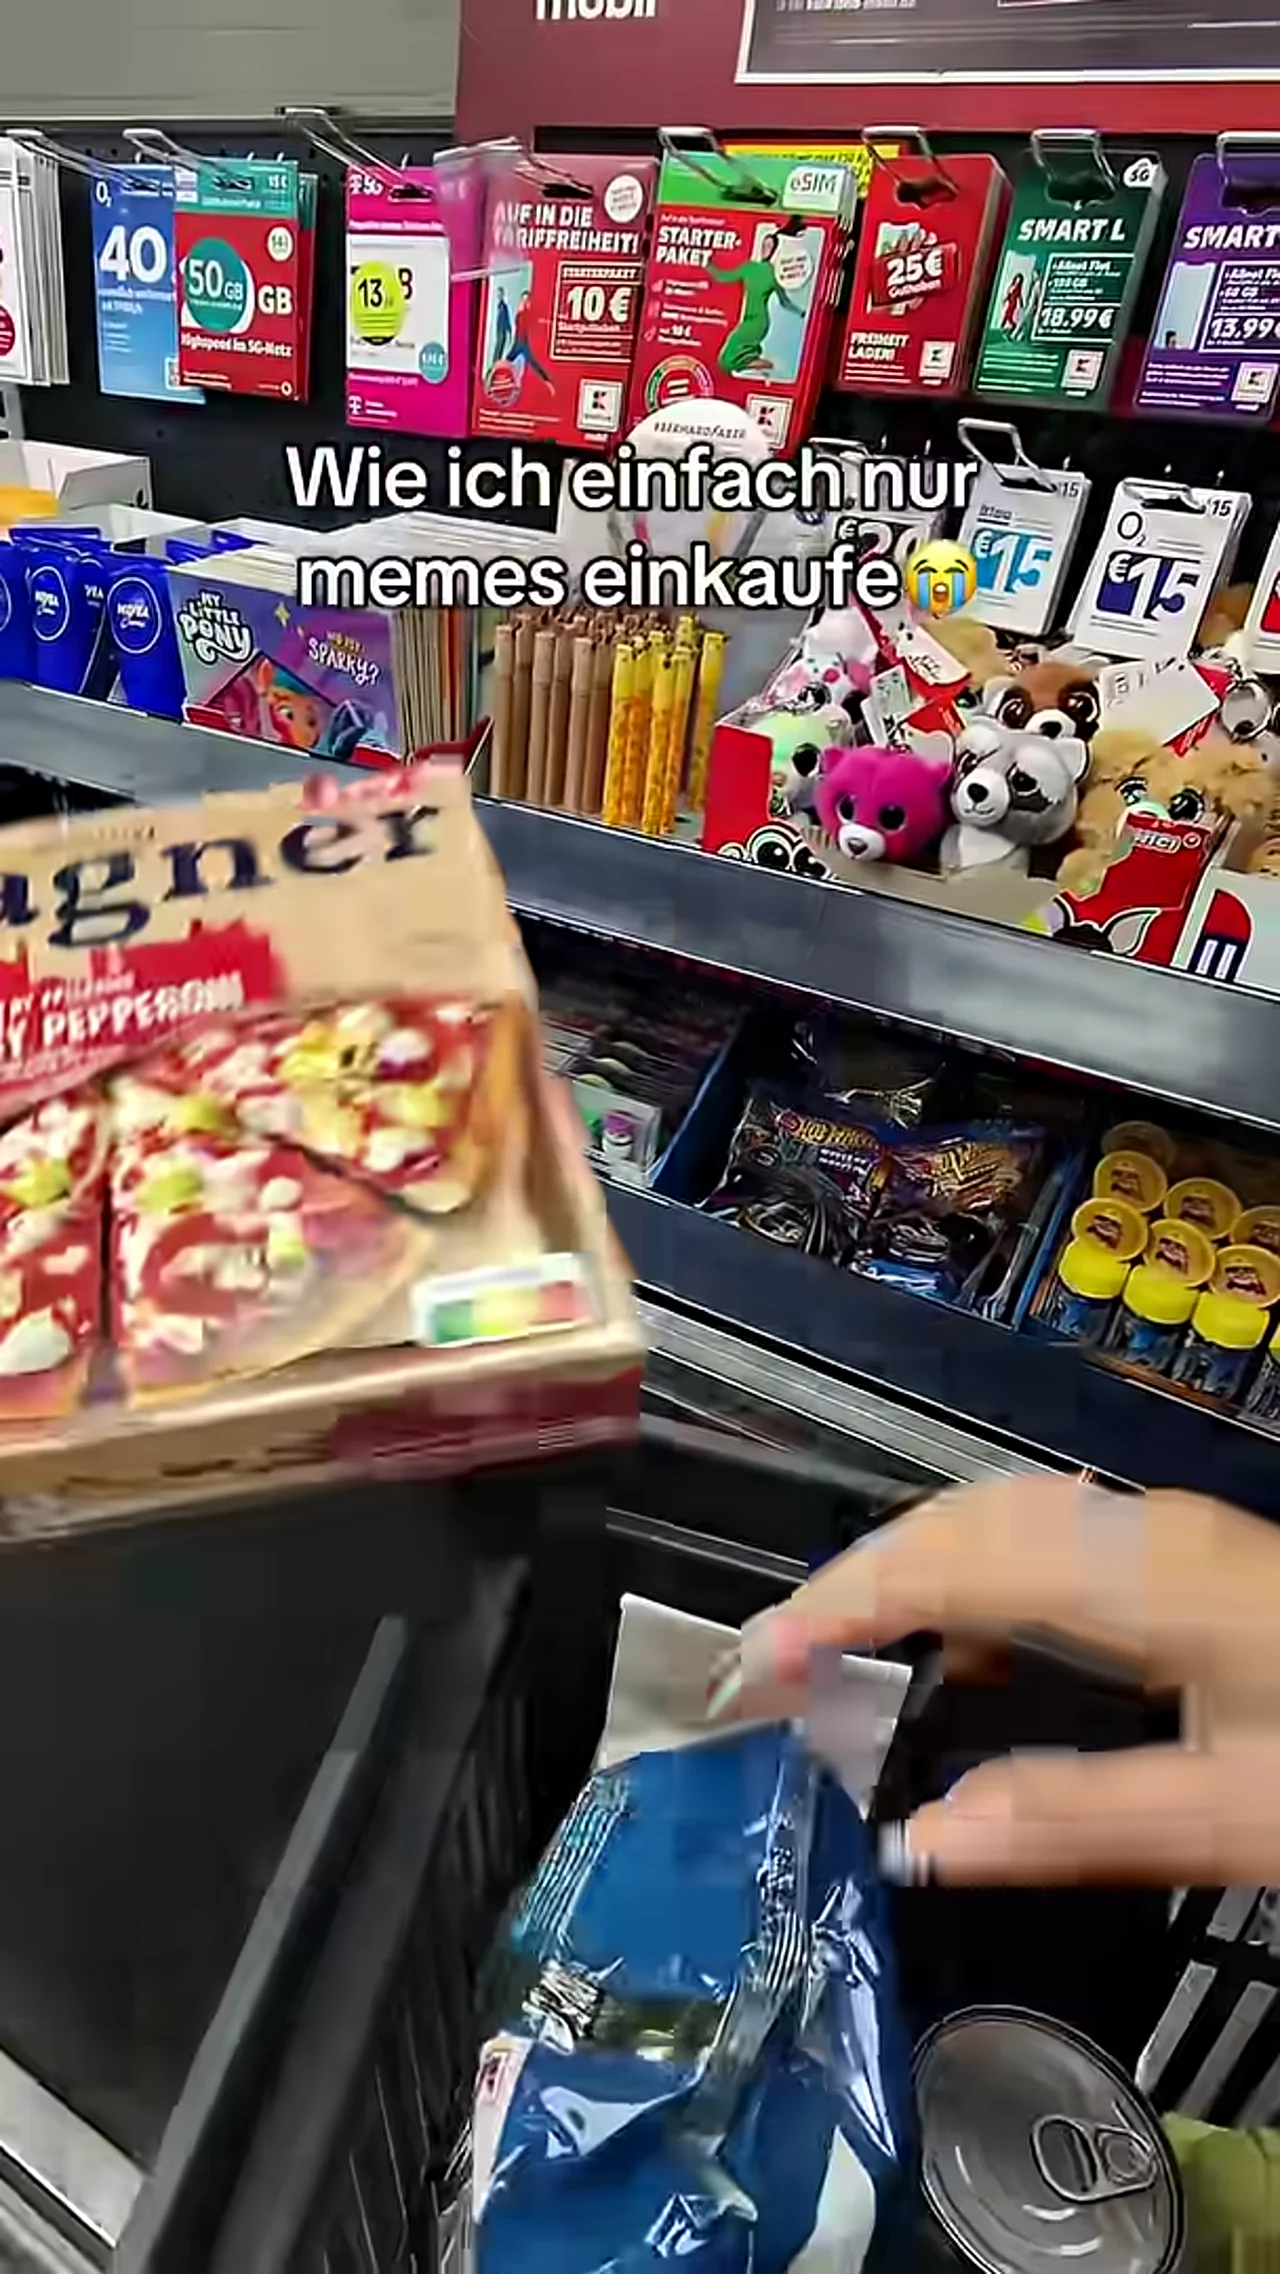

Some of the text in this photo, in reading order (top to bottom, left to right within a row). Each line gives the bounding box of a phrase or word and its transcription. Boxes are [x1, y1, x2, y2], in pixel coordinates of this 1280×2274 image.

[494, 202, 592, 229] AUF IN DIE
[659, 226, 741, 250] STARTER-
[1018, 219, 1126, 241] SMART L
[1184, 225, 1280, 249] SMART
[100, 225, 167, 283] 40
[656, 246, 712, 268] PAKET
[188, 260, 223, 298] 50
[224, 281, 244, 300] GB
[357, 277, 383, 307] 13
[258, 285, 294, 316] GB
[567, 286, 605, 322] 10
[609, 287, 632, 323] €
[1060, 481, 1079, 497] 15
[1211, 500, 1231, 516] 15
[201, 592, 221, 607] MY
[189, 602, 240, 626] LITTLE
[179, 614, 251, 662] PONY
[308, 637, 379, 685] SPARKY?
